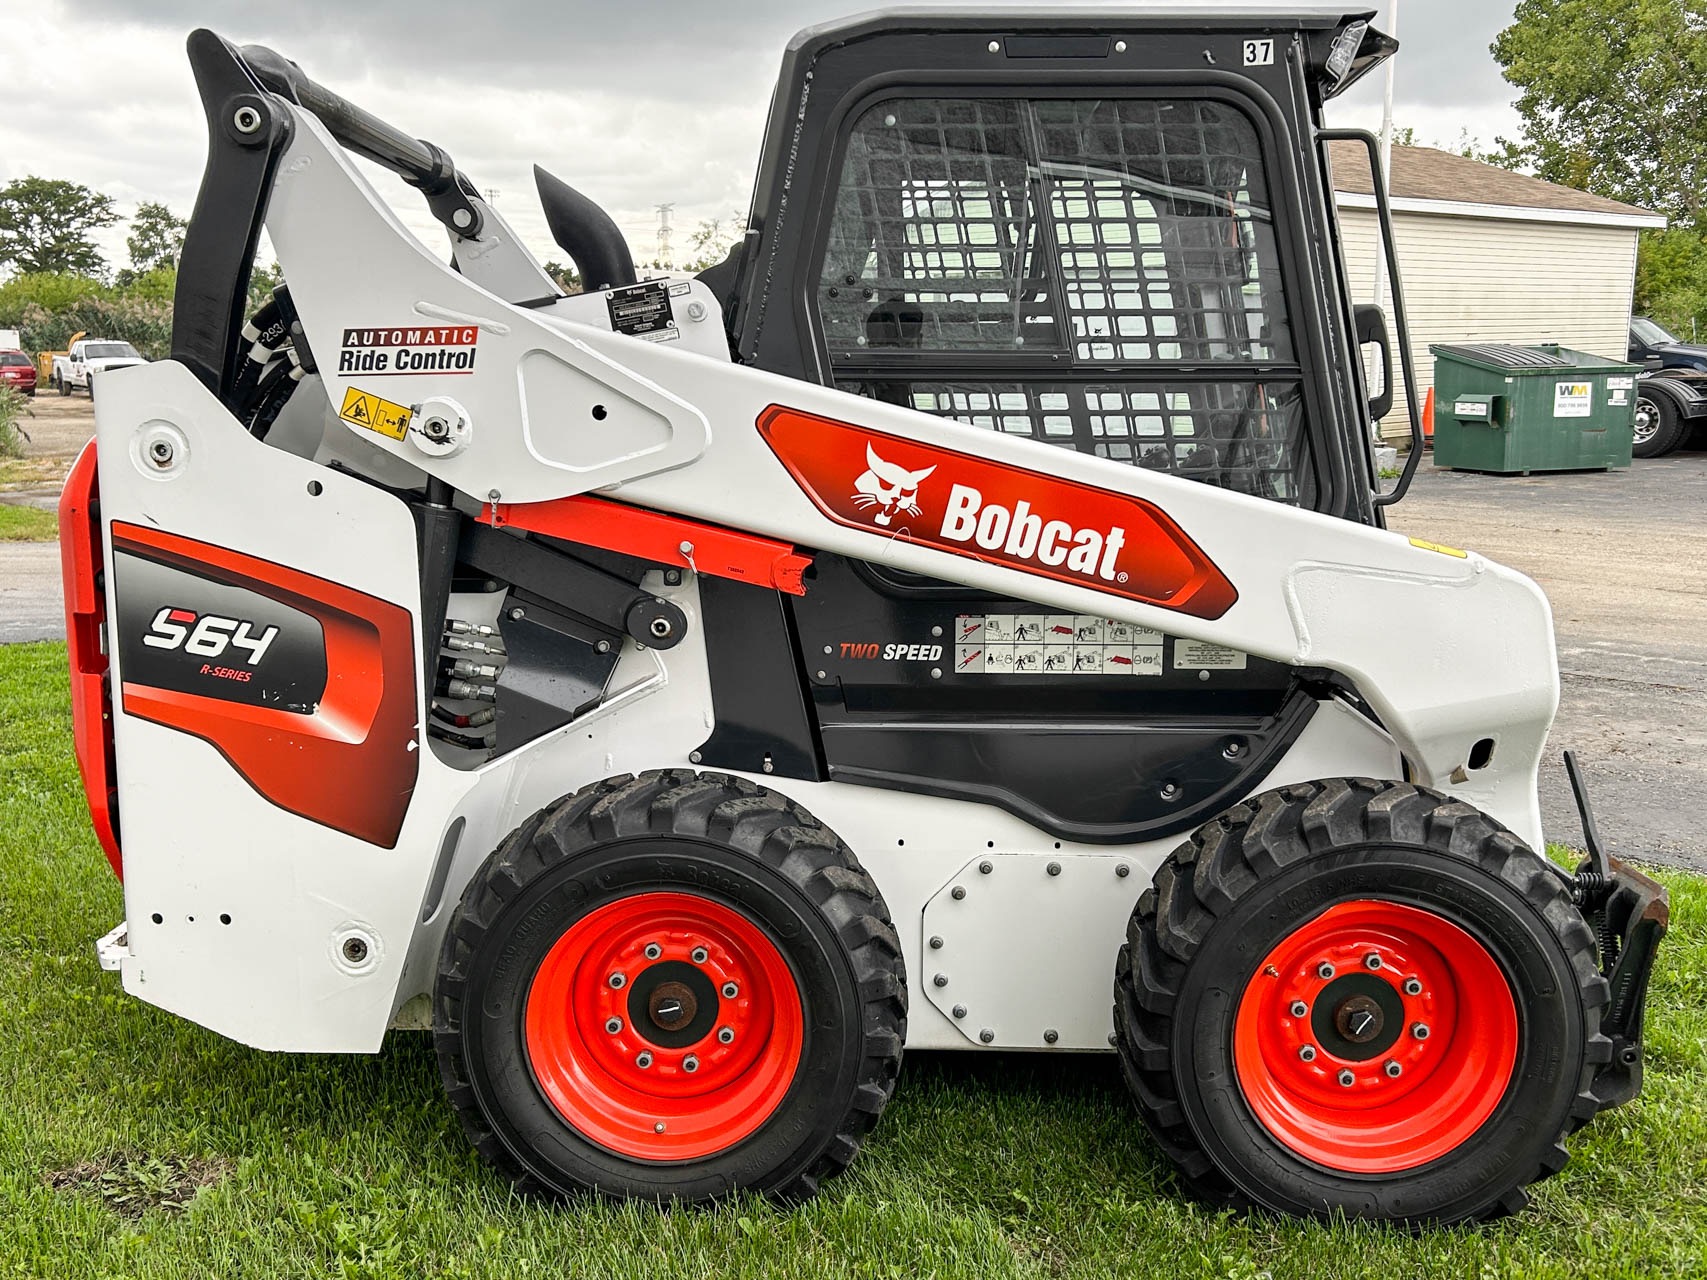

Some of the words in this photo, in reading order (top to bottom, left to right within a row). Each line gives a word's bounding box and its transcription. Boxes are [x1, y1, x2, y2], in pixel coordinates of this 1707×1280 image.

[1246, 42, 1271, 63] 37
[346, 329, 474, 346] AUTOMATIC
[338, 349, 389, 372] Ride
[394, 347, 477, 371] Control
[1558, 384, 1588, 396] WM
[143, 607, 279, 666] S64
[839, 642, 880, 660] TWO
[882, 643, 943, 661] SPEED
[199, 663, 253, 683] R-SERIES
